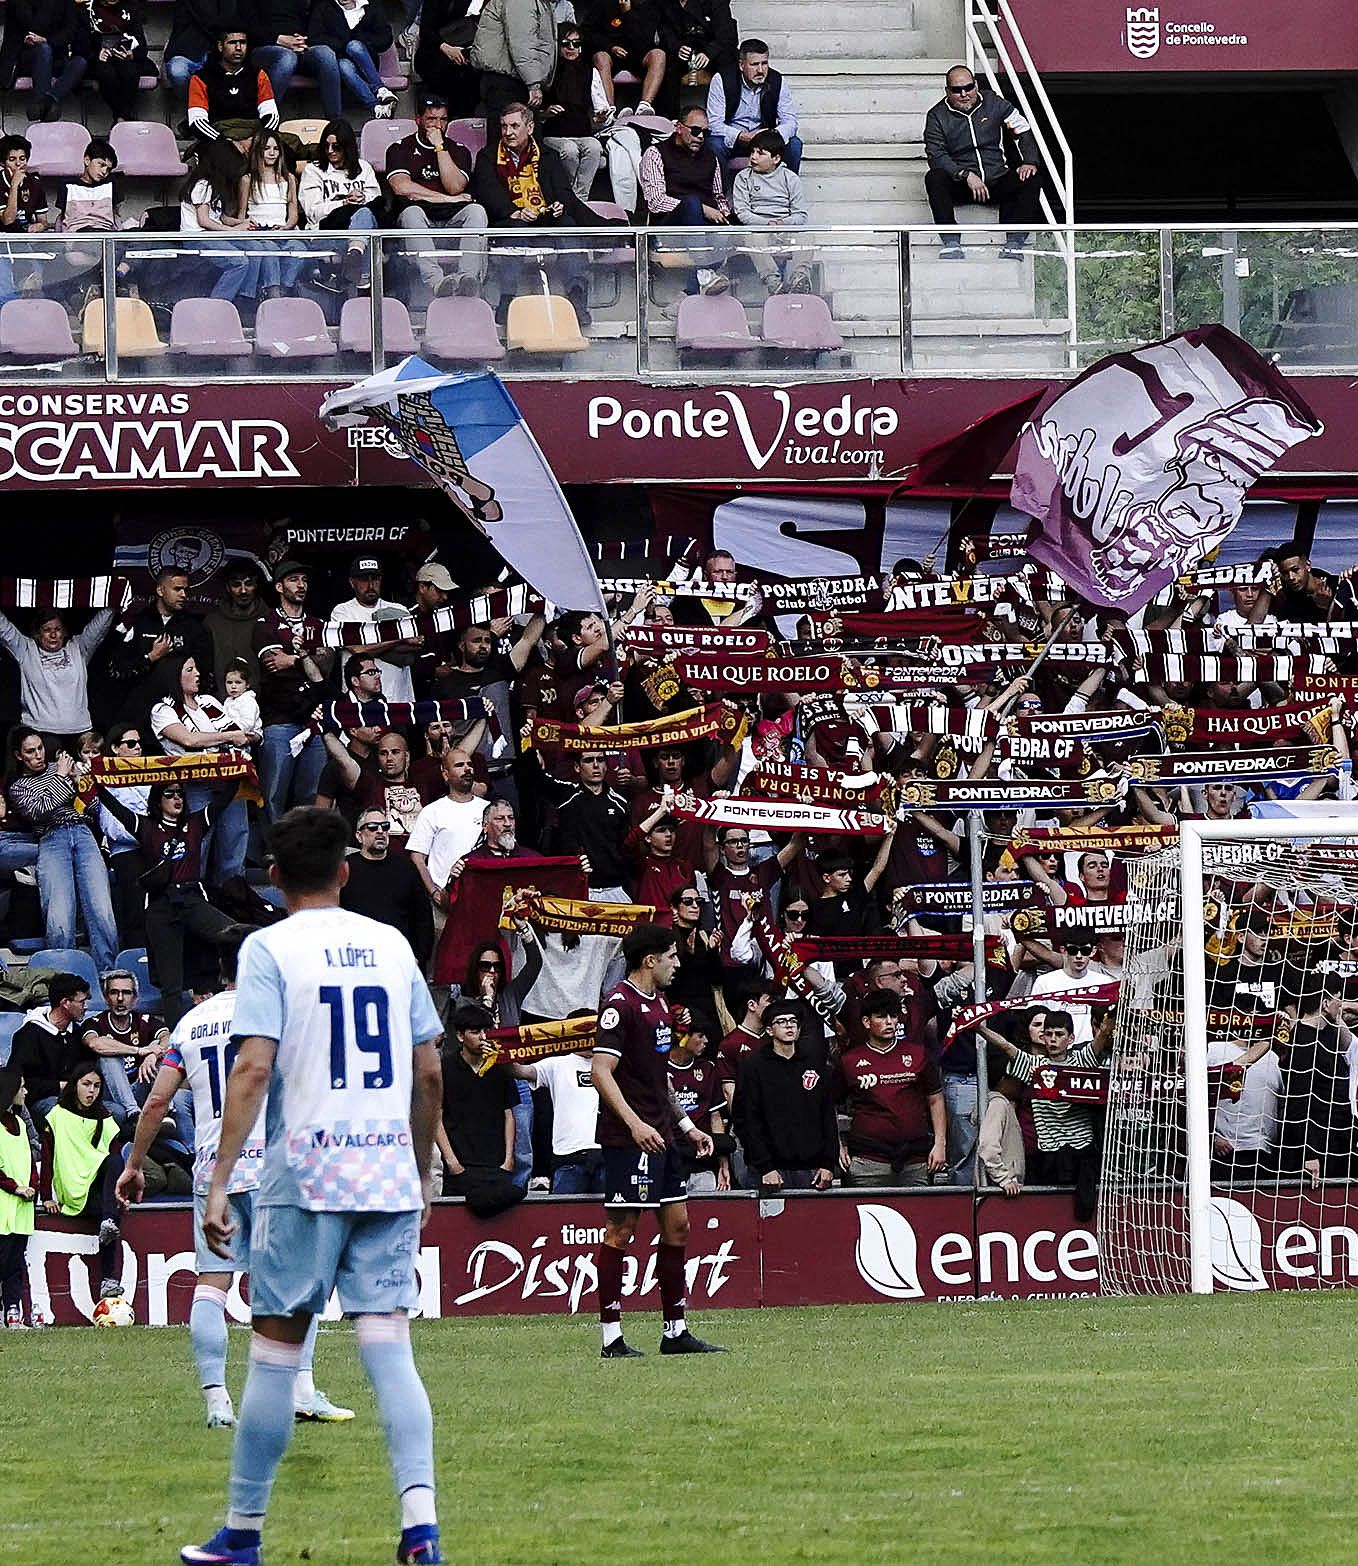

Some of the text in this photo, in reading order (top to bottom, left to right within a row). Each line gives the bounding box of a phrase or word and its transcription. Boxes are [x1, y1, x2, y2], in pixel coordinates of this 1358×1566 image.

[1165, 22, 1215, 33] Concello
[1165, 34, 1248, 45] de Pontevedra
[0, 394, 190, 417] CONSERVAS
[0, 420, 301, 482] CAMAR
[287, 526, 409, 543] PONTEVEDRA CF
[761, 575, 879, 598] PONTEVEDRA
[776, 598, 808, 610] Club
[627, 628, 757, 647] HAI QUE ROELO
[942, 644, 1112, 667] ONTEVEDR
[685, 664, 831, 684] HAI QUE ROELO
[662, 729, 690, 746] BOA
[690, 720, 721, 741] VILA
[1207, 712, 1287, 734] HAI QUE
[1054, 739, 1075, 759] CF
[95, 769, 178, 786] PONTEVEDRA
[192, 766, 218, 780] BOA
[219, 763, 248, 778] VILA
[760, 777, 866, 801] PONTEVEDRA
[724, 805, 831, 820] PONTEVEDRA CF
[1134, 835, 1158, 847] BOA
[1202, 844, 1263, 865] EVEDRA
[925, 888, 1020, 905] PONTEEDRA
[532, 913, 597, 933] ONTEVEDRA
[1055, 905, 1151, 929] PONTEVEDRA
[339, 942, 377, 968] LÓPEZ
[963, 1001, 993, 1021] HAI
[191, 1021, 219, 1041] BORJA
[319, 985, 394, 1090] 19
[509, 1037, 597, 1060] PONTEVEDRA
[1071, 1077, 1100, 1091] HAI
[1151, 1079, 1185, 1091] ROE
[637, 1152, 649, 1175] 4
[561, 1223, 607, 1246] tien
[931, 1229, 1099, 1285] ence
